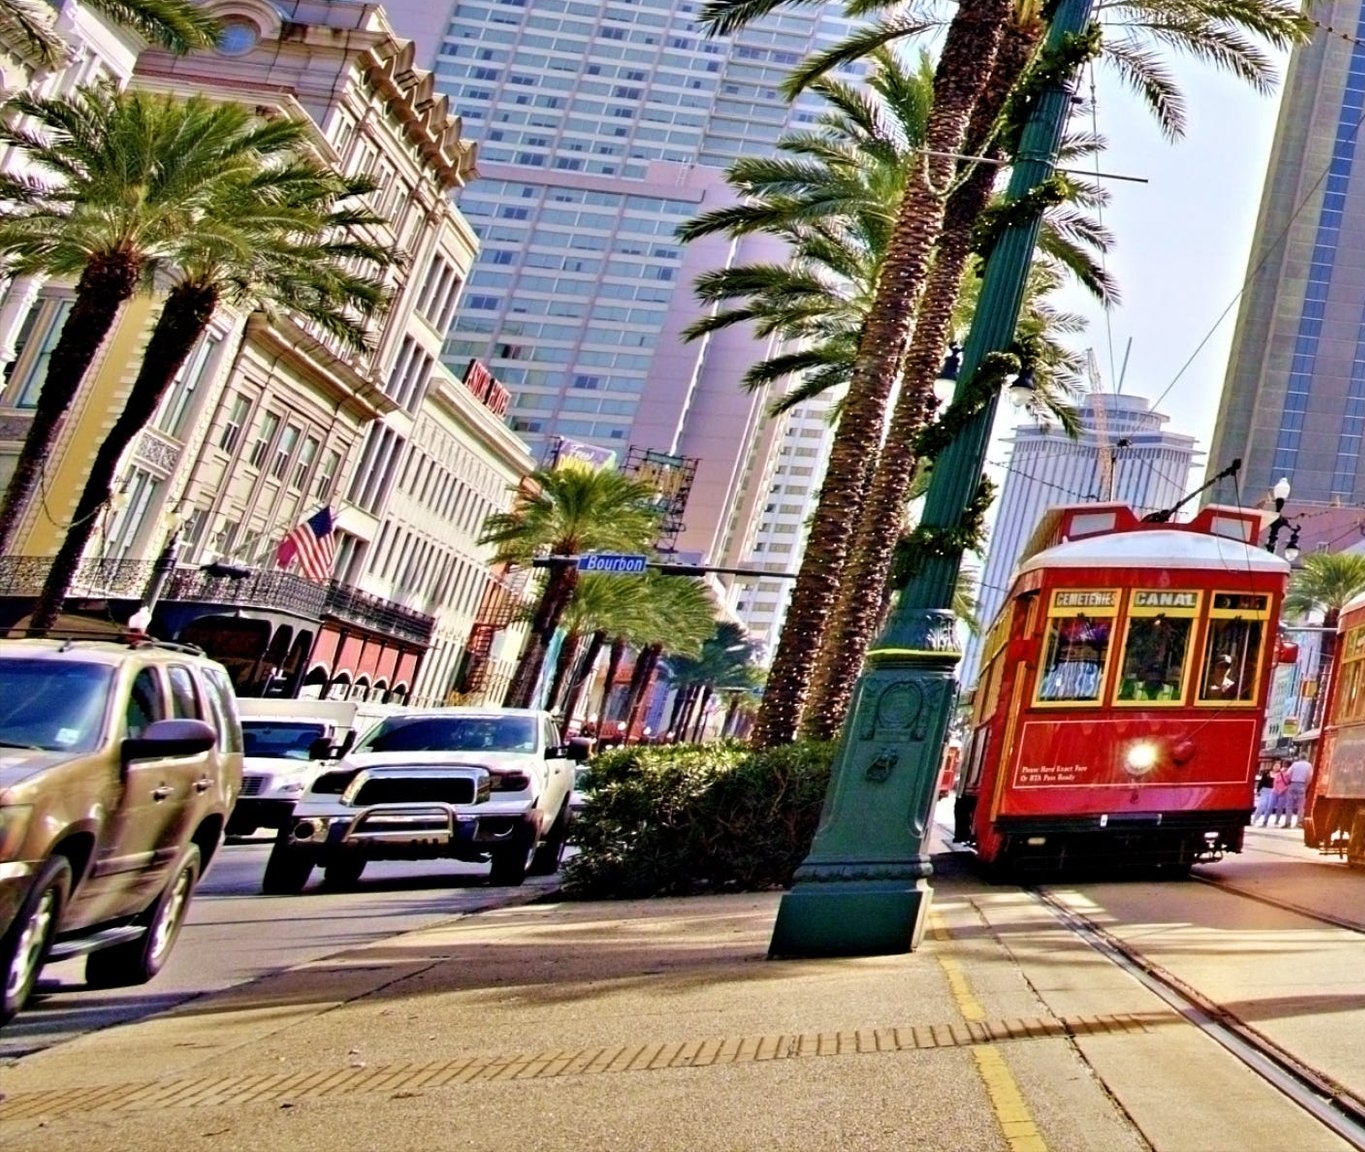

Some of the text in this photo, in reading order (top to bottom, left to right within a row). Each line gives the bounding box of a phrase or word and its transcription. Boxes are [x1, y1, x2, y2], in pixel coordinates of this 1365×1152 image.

[587, 555, 643, 571] Bourbon
[1056, 592, 1117, 606] CEMETERIES
[1135, 592, 1196, 606] CANAL
